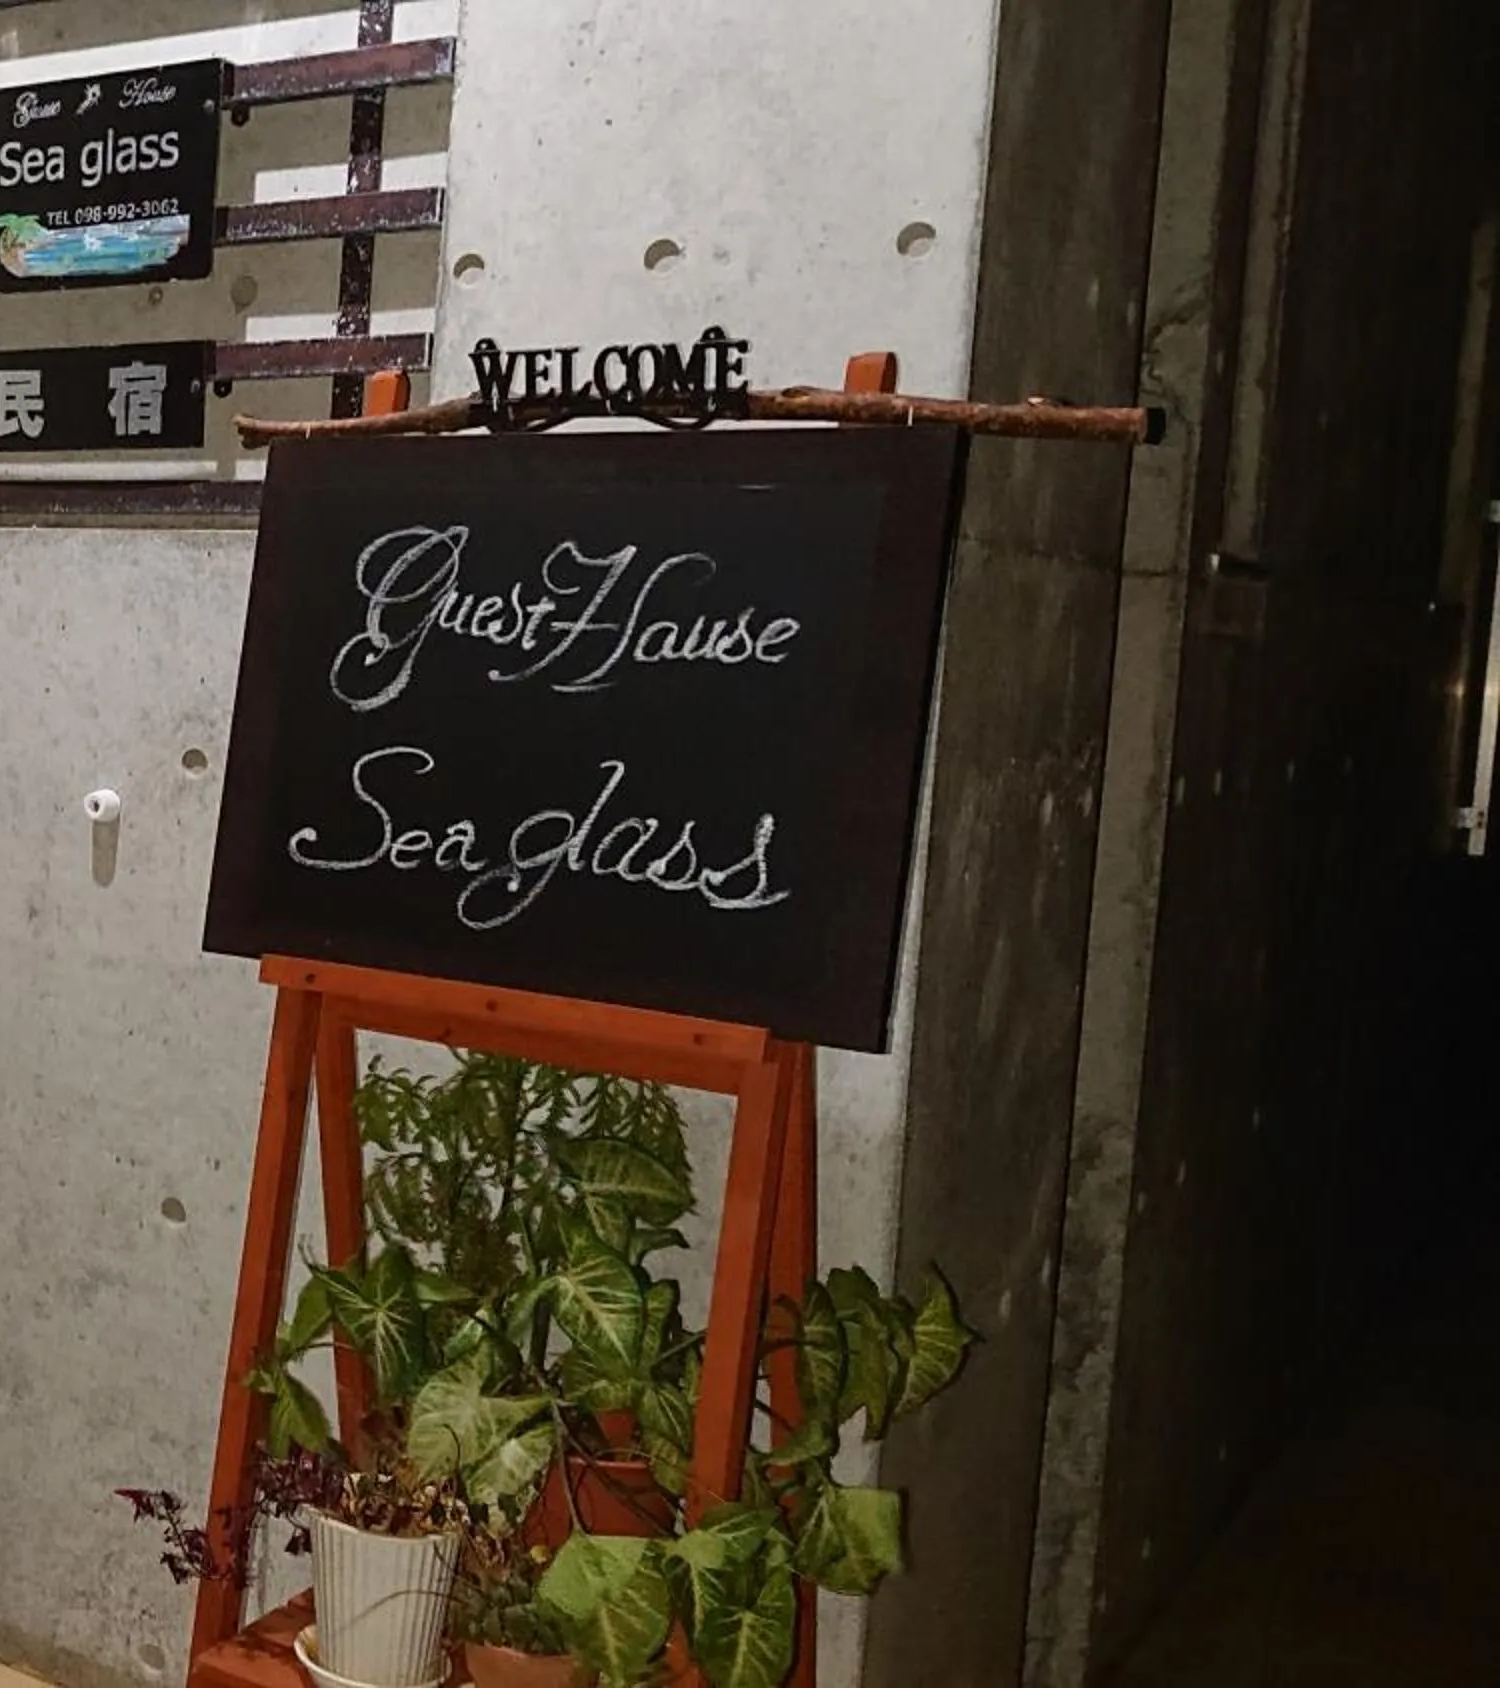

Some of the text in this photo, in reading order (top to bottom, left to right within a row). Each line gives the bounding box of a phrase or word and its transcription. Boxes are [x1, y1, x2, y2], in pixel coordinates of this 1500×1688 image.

[0, 127, 180, 187] Sea glass
[47, 198, 179, 226] TEL 098-992-3062
[469, 340, 750, 404] WELCOME
[330, 525, 555, 711] Guest
[289, 746, 790, 930] Sea glass
